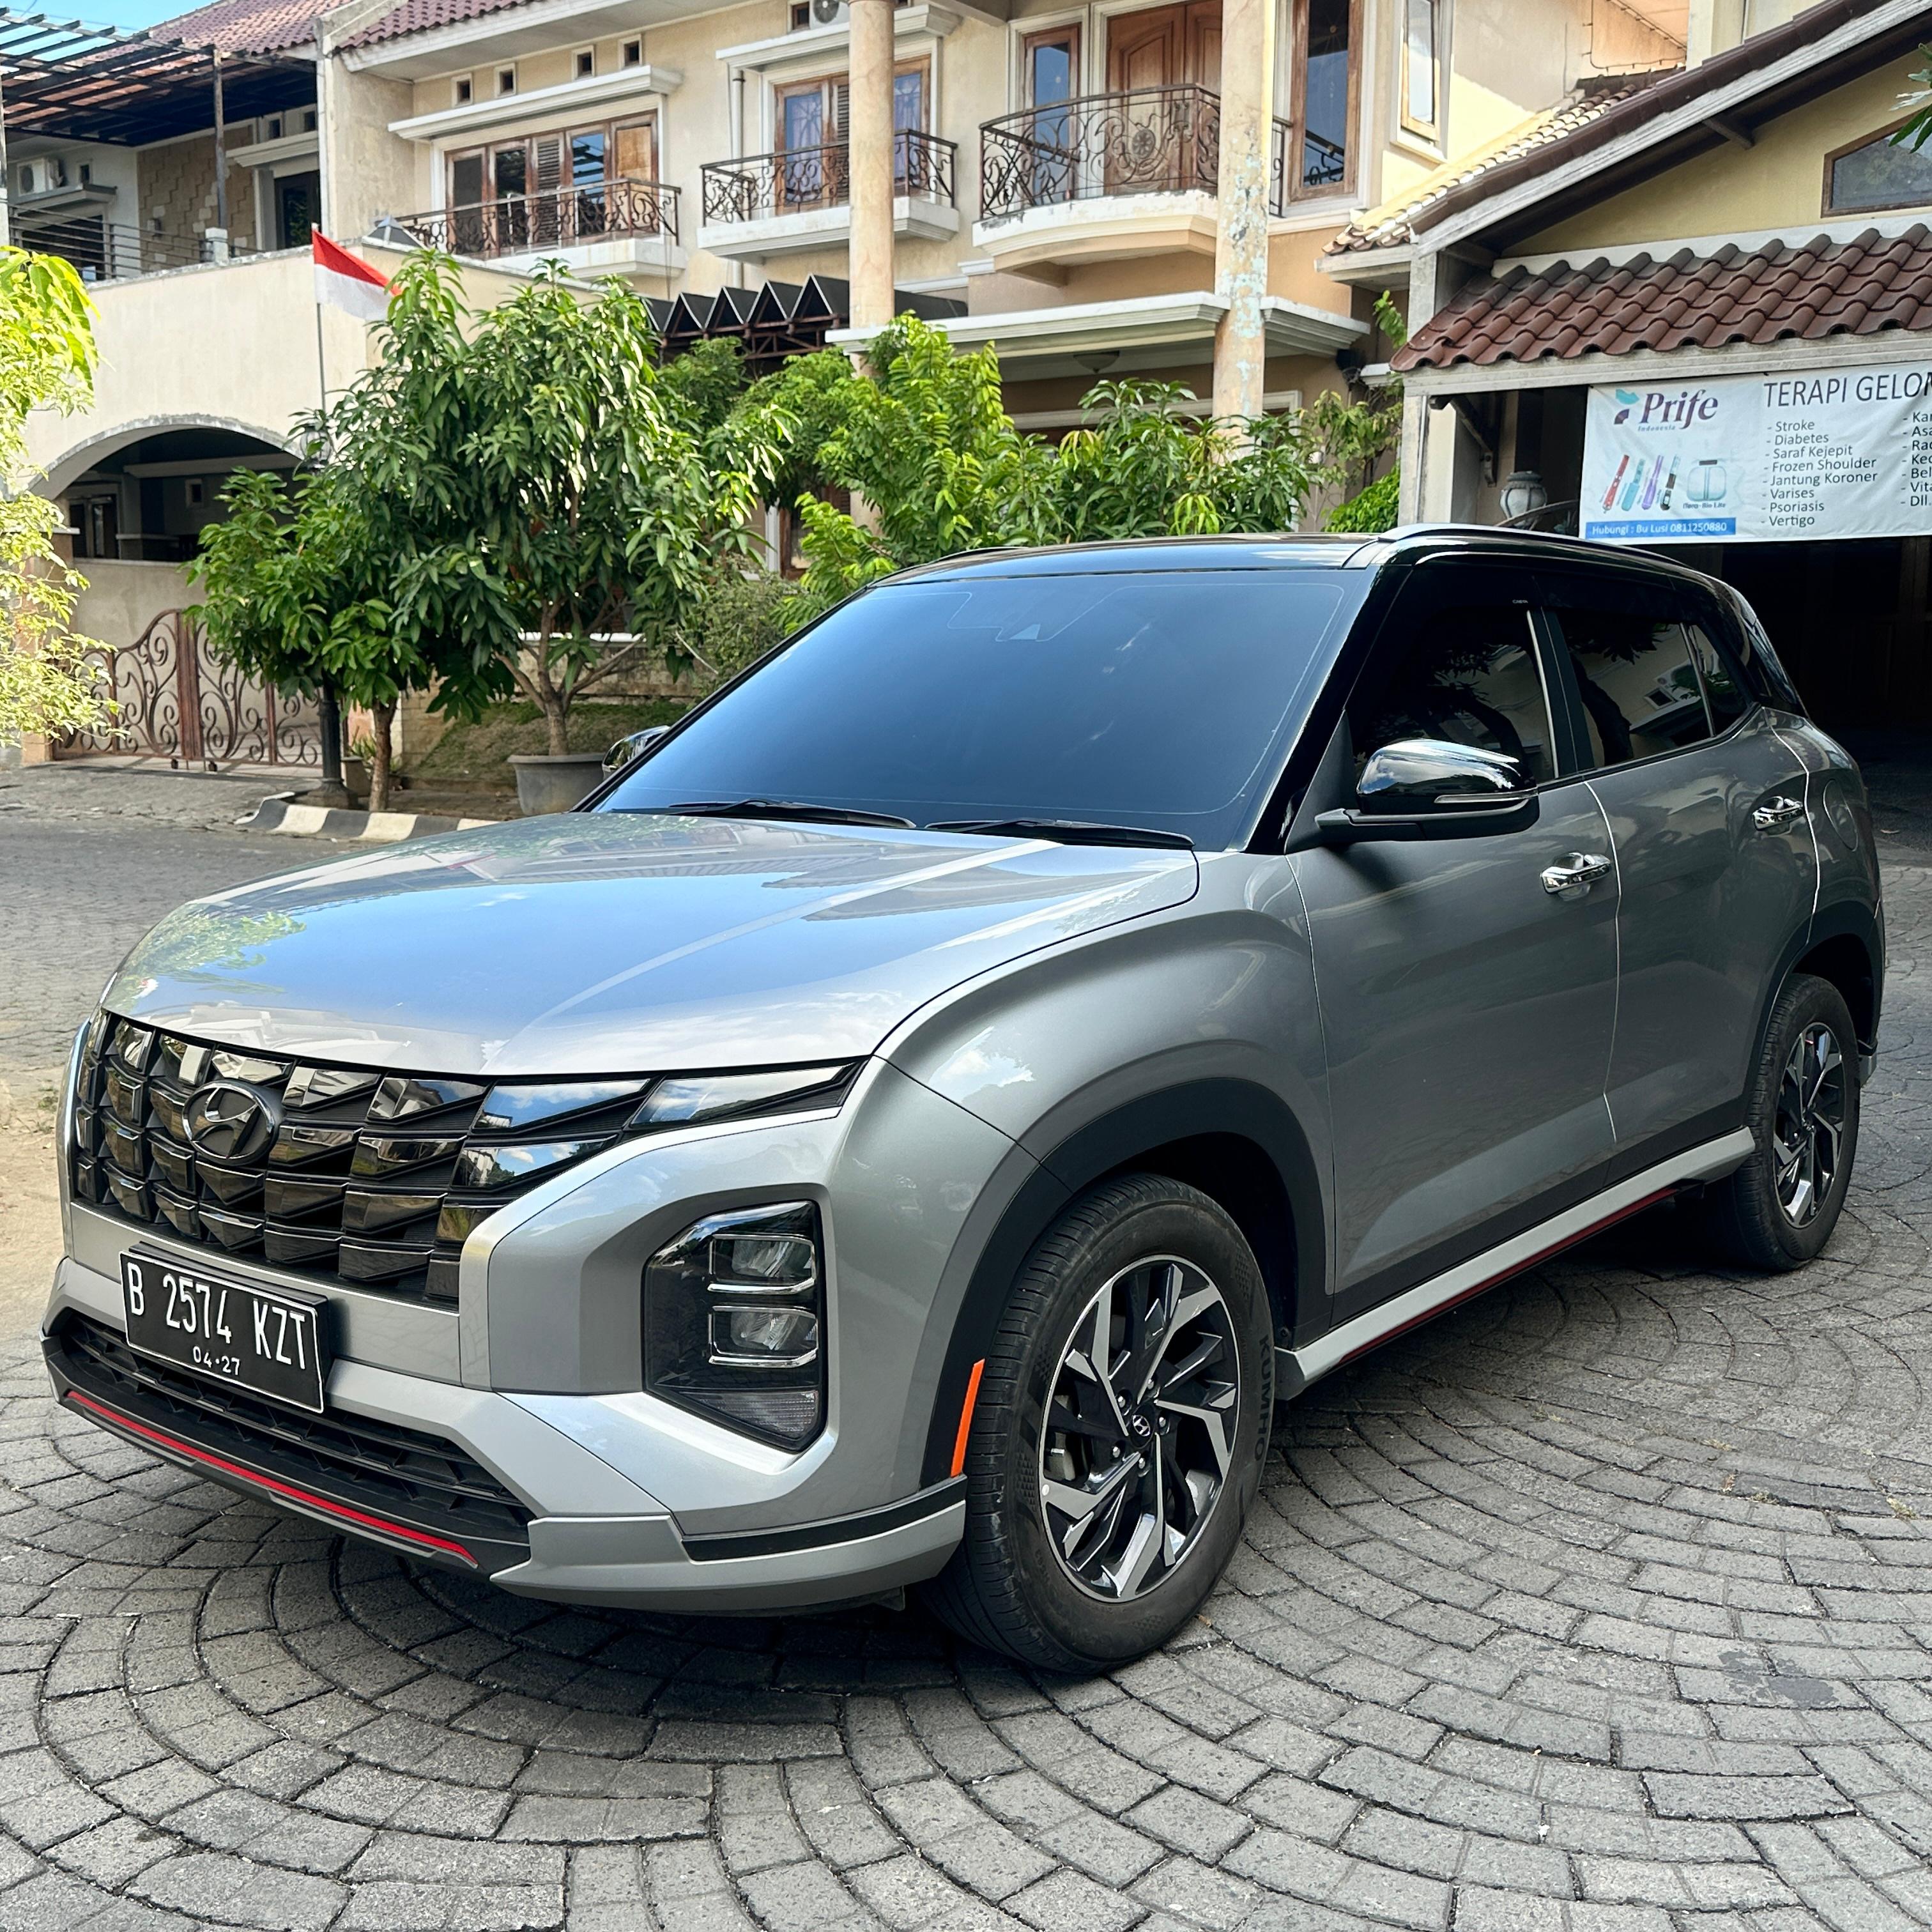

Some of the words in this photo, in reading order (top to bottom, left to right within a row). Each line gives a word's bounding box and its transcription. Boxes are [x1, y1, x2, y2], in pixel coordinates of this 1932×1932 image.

[1764, 378, 1847, 407] TERAPI
[1639, 389, 1719, 429] Prife
[1775, 420, 1814, 432] Stroke
[1775, 433, 1829, 445] Diabetes
[1773, 446, 1805, 459] Saraf
[1809, 445, 1853, 459] Kejepit
[1772, 461, 1813, 472] Frozen
[1818, 457, 1876, 470] Shoulder
[1770, 475, 1820, 486] Jantung
[1825, 472, 1878, 484] Koroner
[1770, 489, 1814, 499] Varises
[1770, 500, 1825, 512] Psoriasis
[1769, 516, 1815, 528] Vertigo
[1592, 525, 1629, 535] Hubungi
[1636, 525, 1648, 533] Bu
[1651, 524, 1668, 533] Lusi
[128, 1262, 144, 1316] B
[162, 1273, 232, 1344] 2574
[253, 1298, 306, 1370] KZT
[1255, 1334, 1271, 1461] KUMHO
